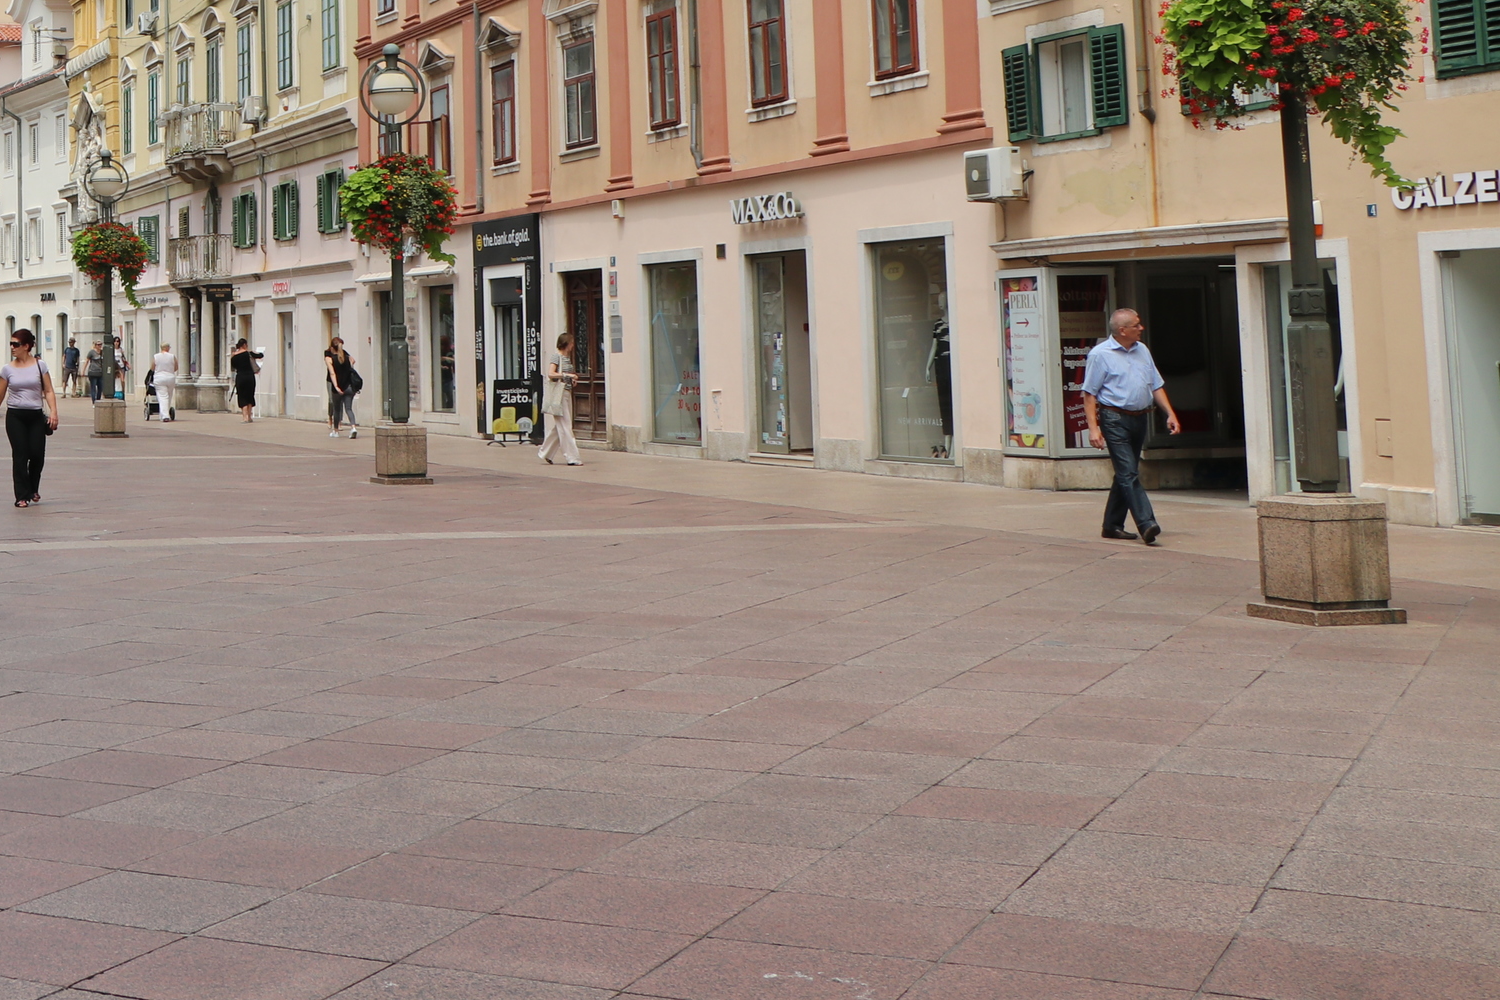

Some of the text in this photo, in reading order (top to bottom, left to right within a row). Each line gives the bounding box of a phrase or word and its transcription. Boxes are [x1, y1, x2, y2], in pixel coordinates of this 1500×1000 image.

[1370, 205, 1377, 216] 4
[482, 227, 531, 248] the.bank.of.gold.
[40, 292, 56, 302] ZARA
[1010, 293, 1038, 309] PERLA
[683, 371, 699, 380] SALE
[496, 387, 529, 395] Investicijsko
[500, 393, 532, 404] Zlato.
[914, 417, 943, 427] ARRIVALS
